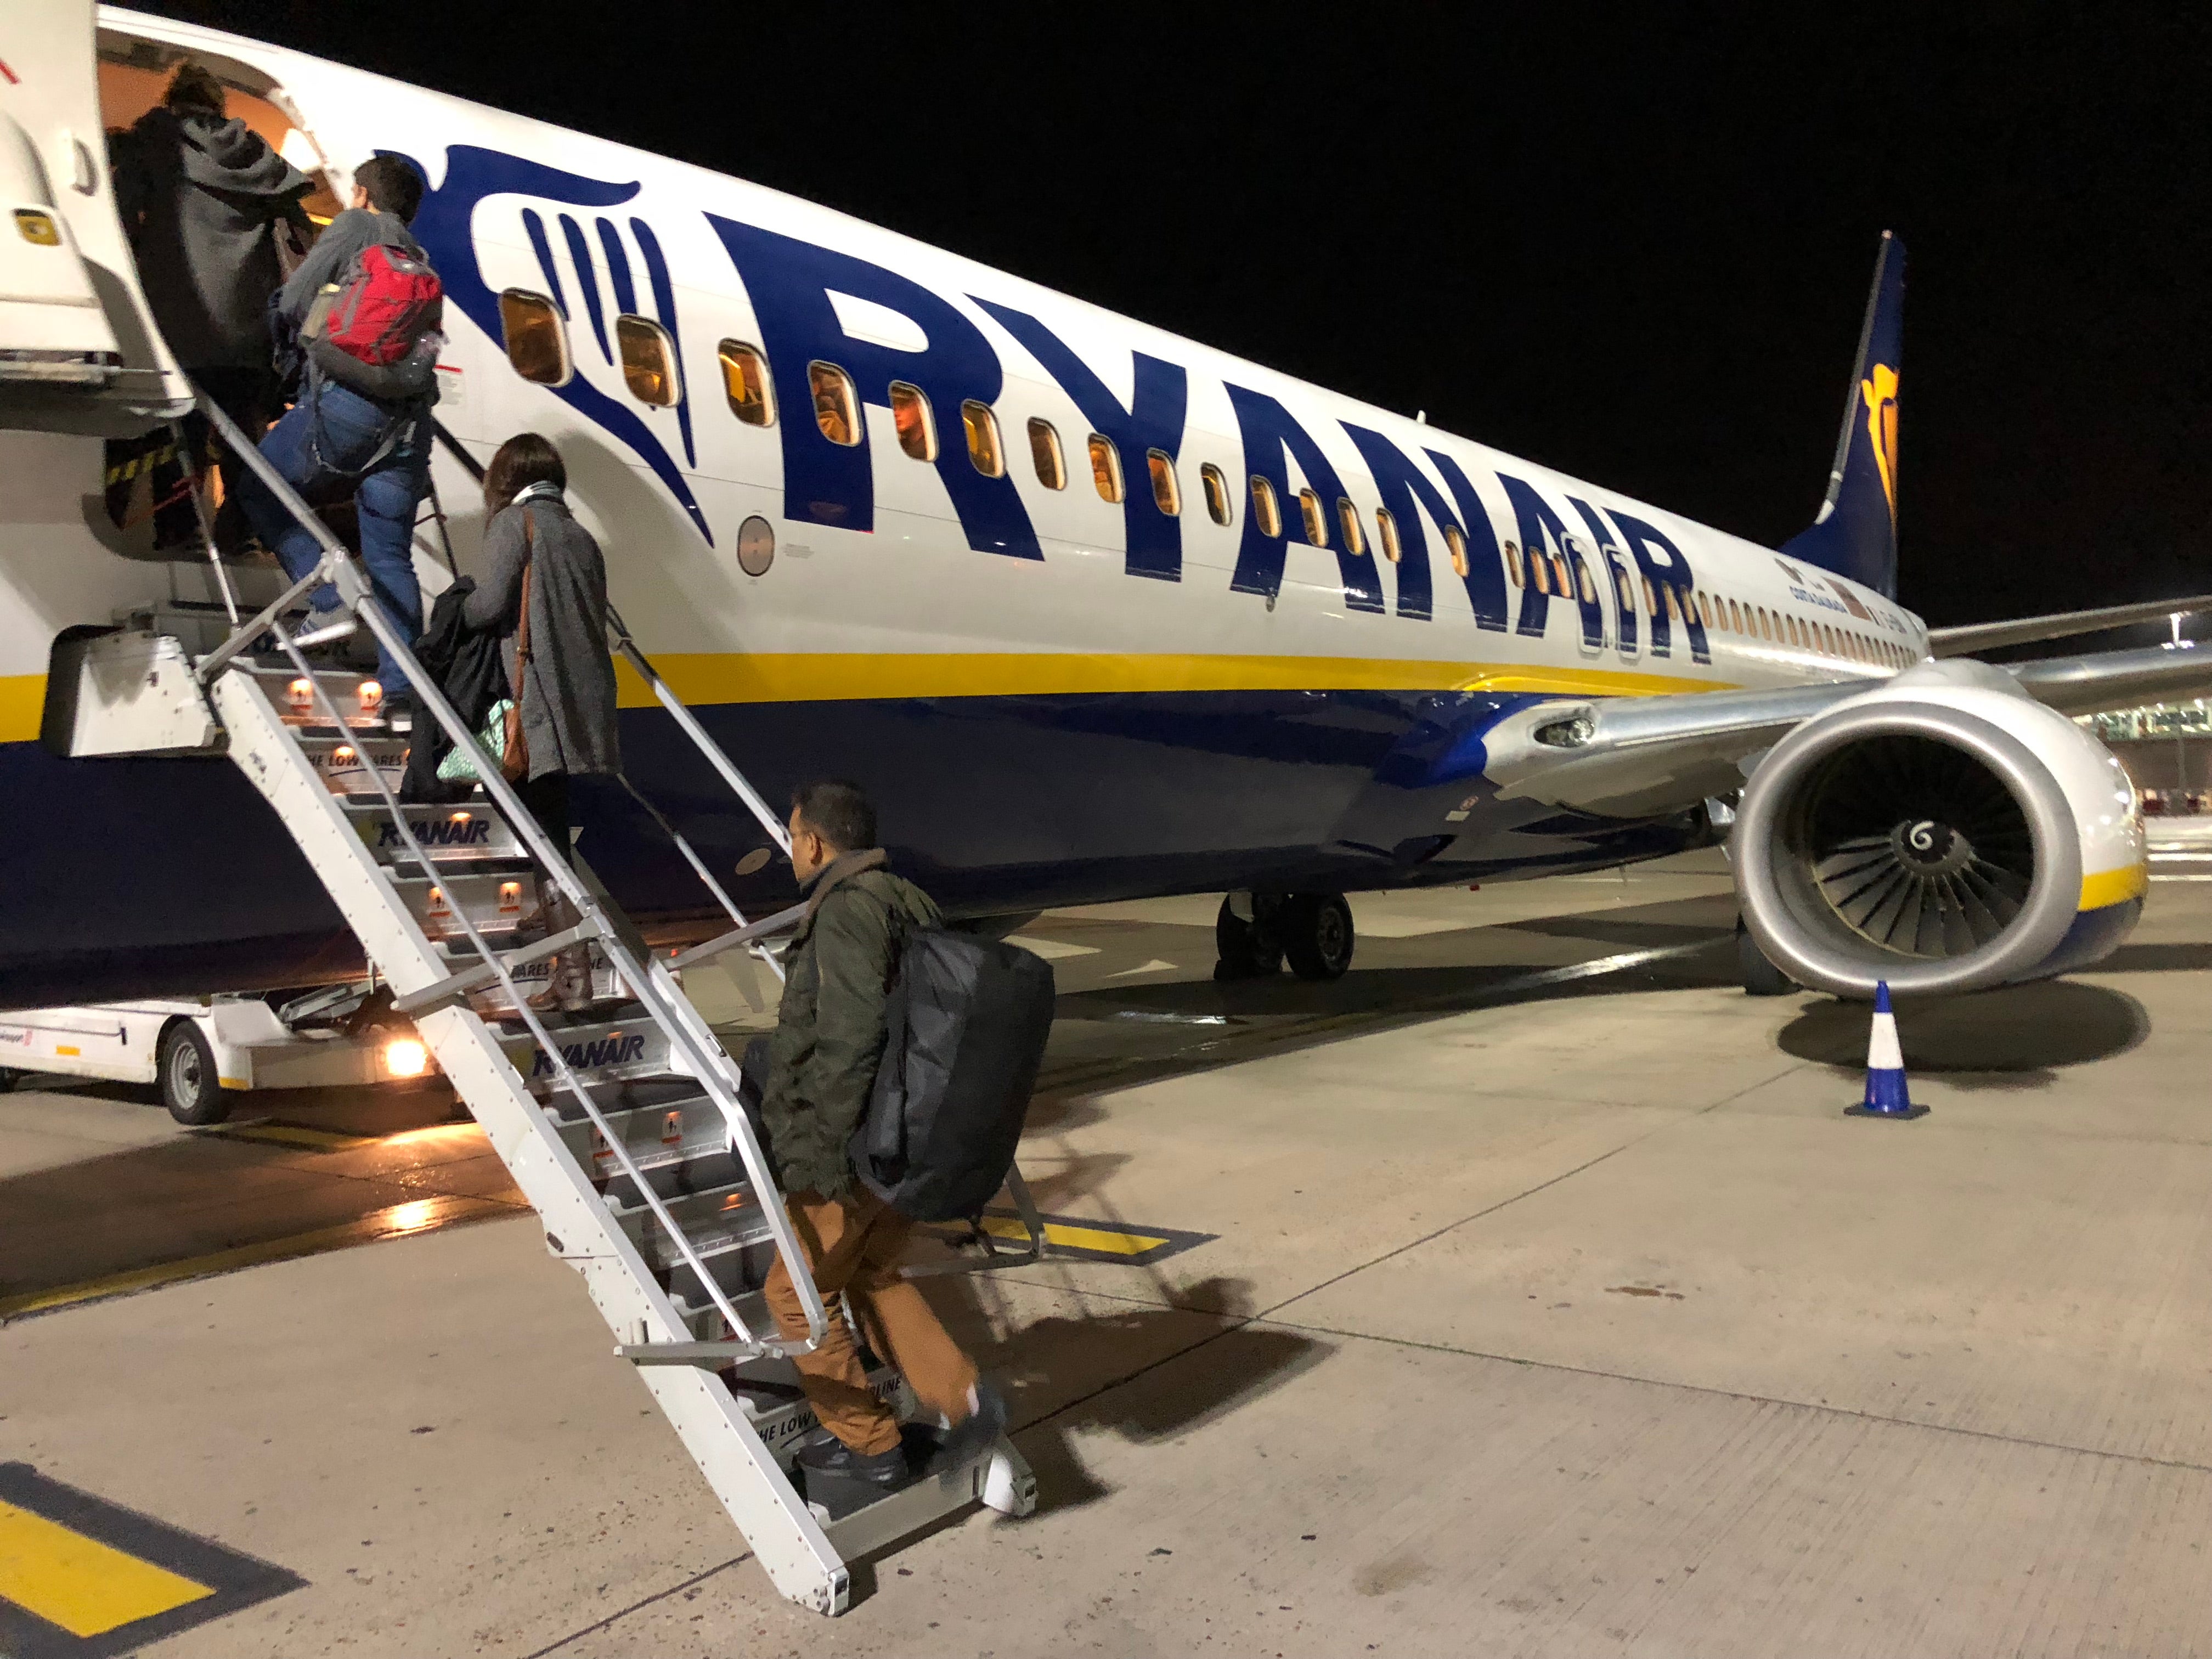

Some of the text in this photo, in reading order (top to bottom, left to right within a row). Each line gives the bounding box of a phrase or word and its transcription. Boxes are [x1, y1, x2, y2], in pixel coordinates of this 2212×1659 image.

[702, 211, 1712, 665] RYANAIR
[757, 1424, 776, 1443] HE
[780, 1412, 811, 1437] LOW
